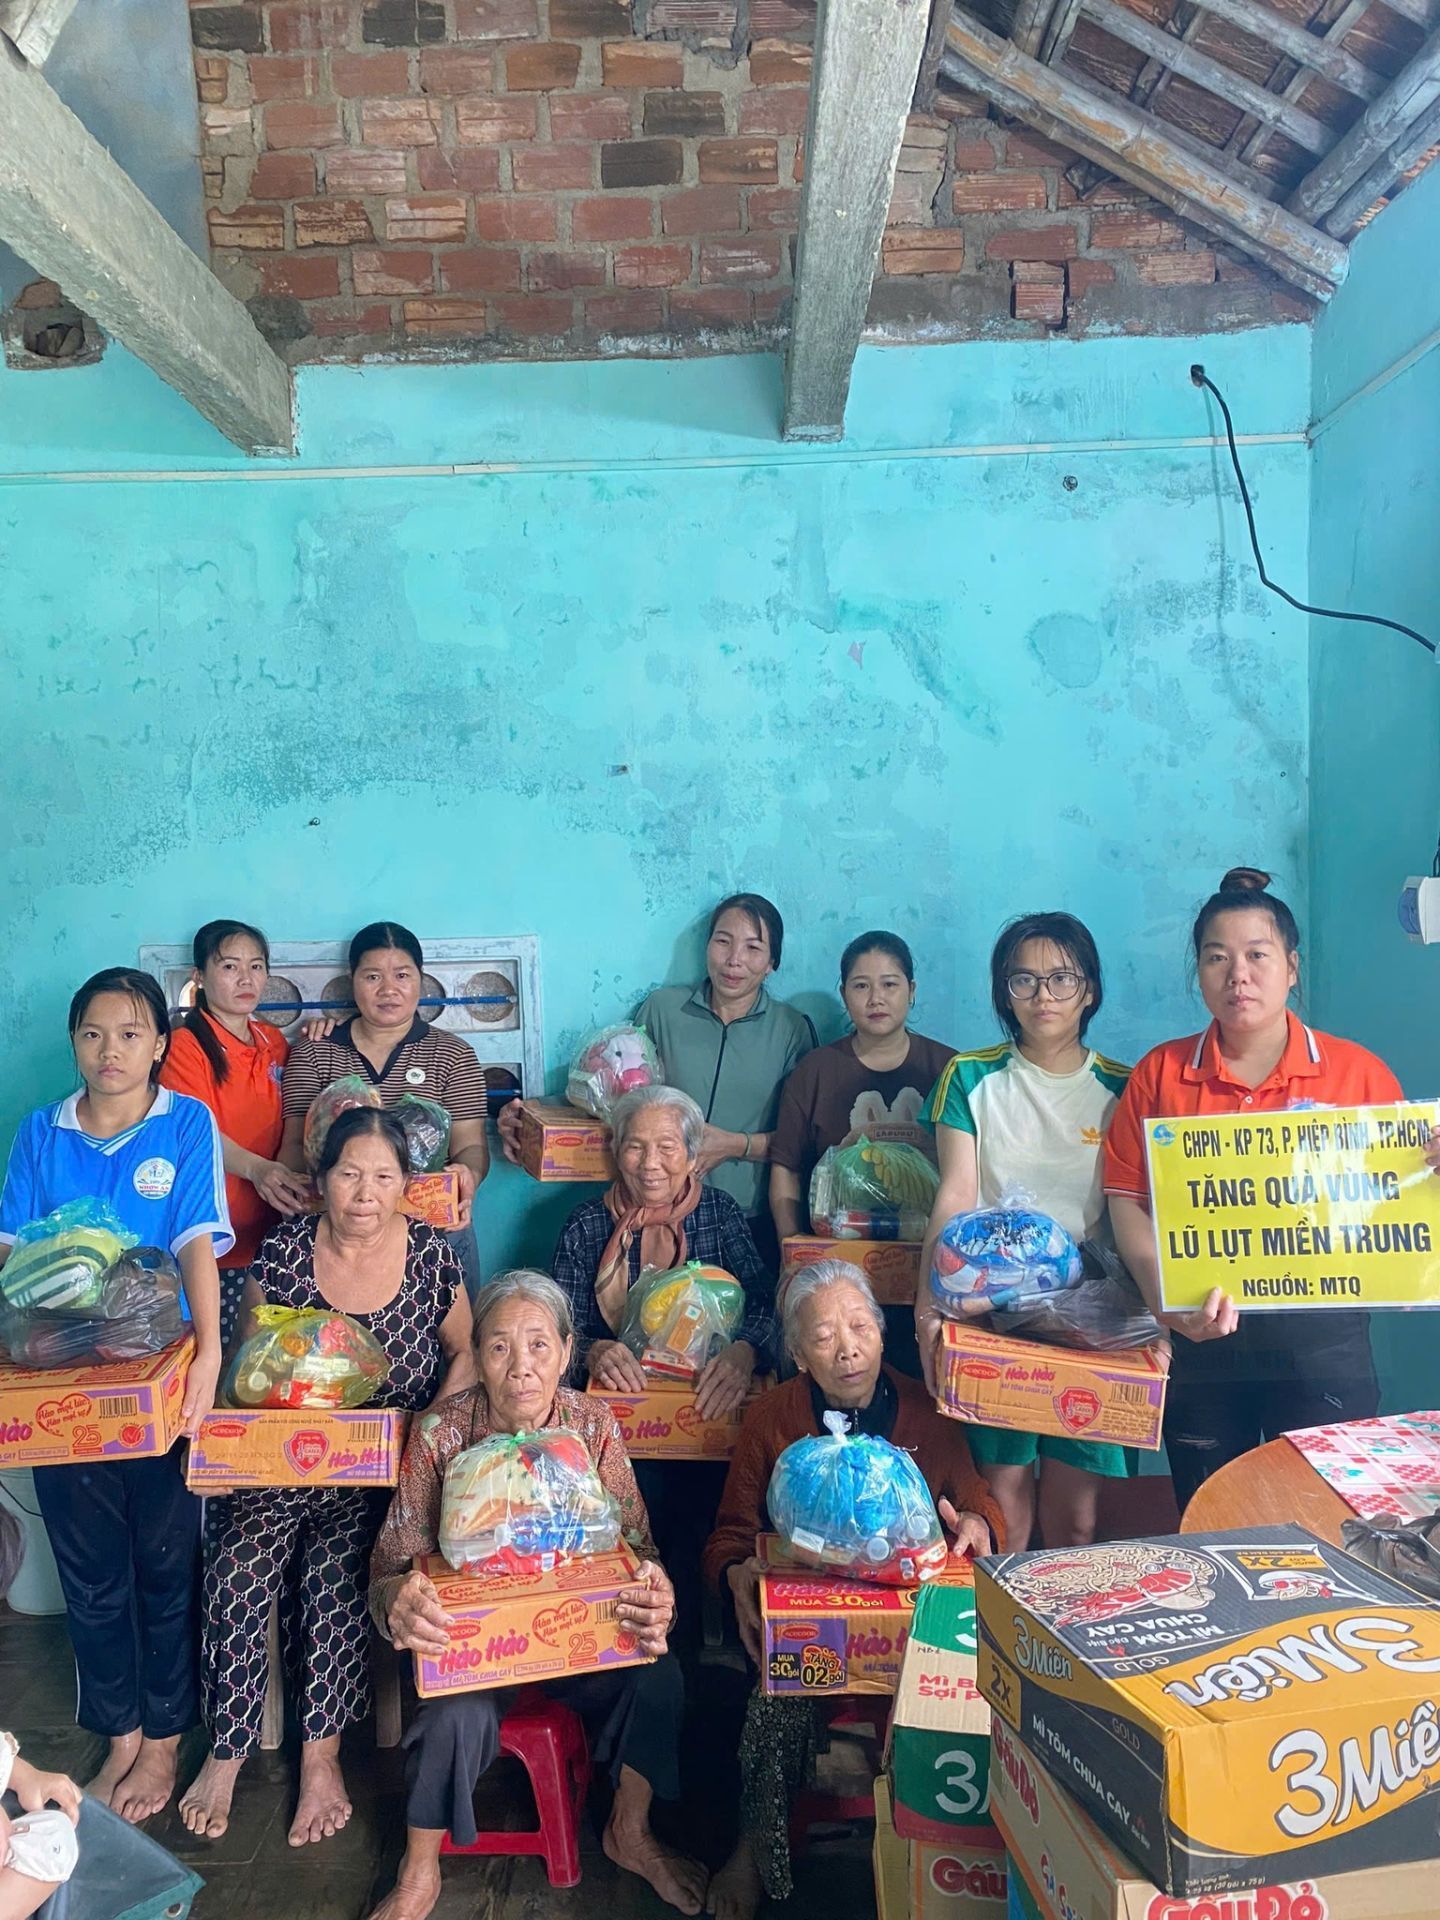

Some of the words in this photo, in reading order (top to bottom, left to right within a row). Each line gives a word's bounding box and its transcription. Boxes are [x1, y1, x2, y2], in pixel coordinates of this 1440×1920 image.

[1183, 1129, 1221, 1158] CHPN
[1234, 1128, 1252, 1156] KP
[1257, 1127, 1279, 1157] 73,
[1298, 1119, 1329, 1159] HIỆP
[1187, 1174, 1256, 1213] TẶNG
[1265, 1173, 1319, 1206] QUÀ
[1325, 1167, 1400, 1203] VÙNG
[1169, 1225, 1199, 1259] LŨ
[1208, 1228, 1252, 1264] LỤT
[1261, 1218, 1332, 1257] MIỀN
[1339, 1222, 1432, 1254] TRUNG
[1242, 1272, 1314, 1297] NGUỒN:
[1320, 1276, 1361, 1297] MTQ
[72, 1424, 101, 1448] 25
[636, 1417, 671, 1439] Hảo
[328, 1448, 358, 1469] Hảo
[1086, 1623, 1135, 1638] CAY
[1135, 1613, 1208, 1630] CHUA
[1190, 1625, 1225, 1640] MÌ
[569, 1631, 597, 1659] 25
[846, 1627, 892, 1659] Hảo
[1132, 1628, 1190, 1647] TÔM
[439, 1641, 482, 1675] Hảo
[486, 1628, 529, 1662] Hảo
[1113, 1656, 1169, 1672] GOLD
[919, 1674, 949, 1686] Mì
[918, 1686, 957, 1701] Sợi
[1112, 1718, 1140, 1750] GOLD
[1033, 1714, 1045, 1738] MÌ
[1047, 1729, 1071, 1764] TÔM
[1073, 1756, 1105, 1800] CHUA
[1107, 1791, 1130, 1825] CAY
